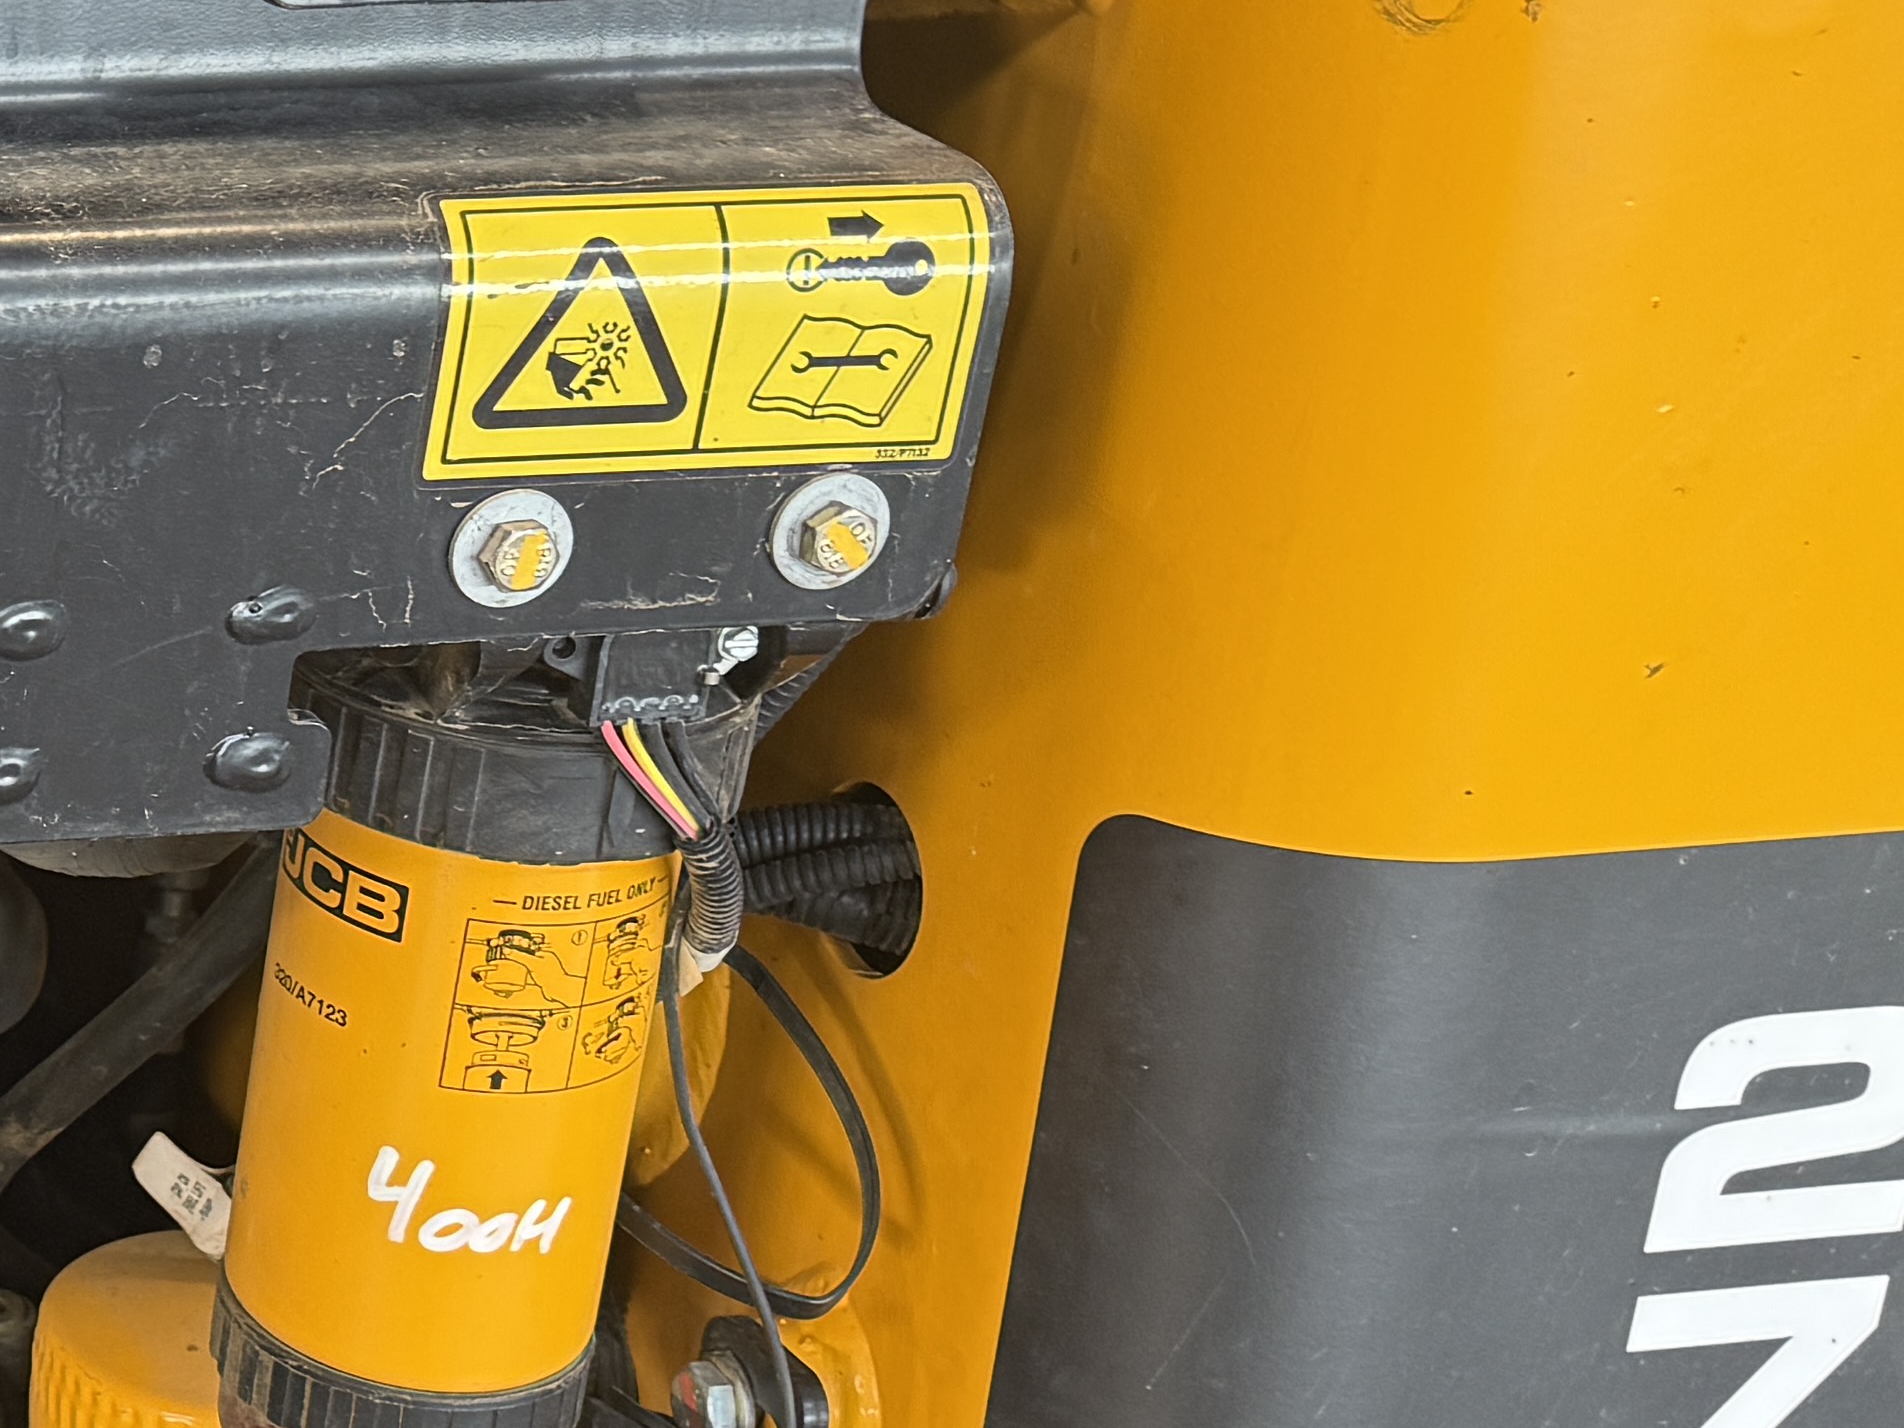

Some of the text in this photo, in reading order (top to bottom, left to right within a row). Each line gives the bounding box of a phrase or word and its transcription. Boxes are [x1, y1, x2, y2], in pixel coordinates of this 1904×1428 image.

[284, 827, 403, 935] JCB
[521, 876, 658, 912] DIESEL FUEL ONLY
[367, 1144, 573, 1255] 400H
